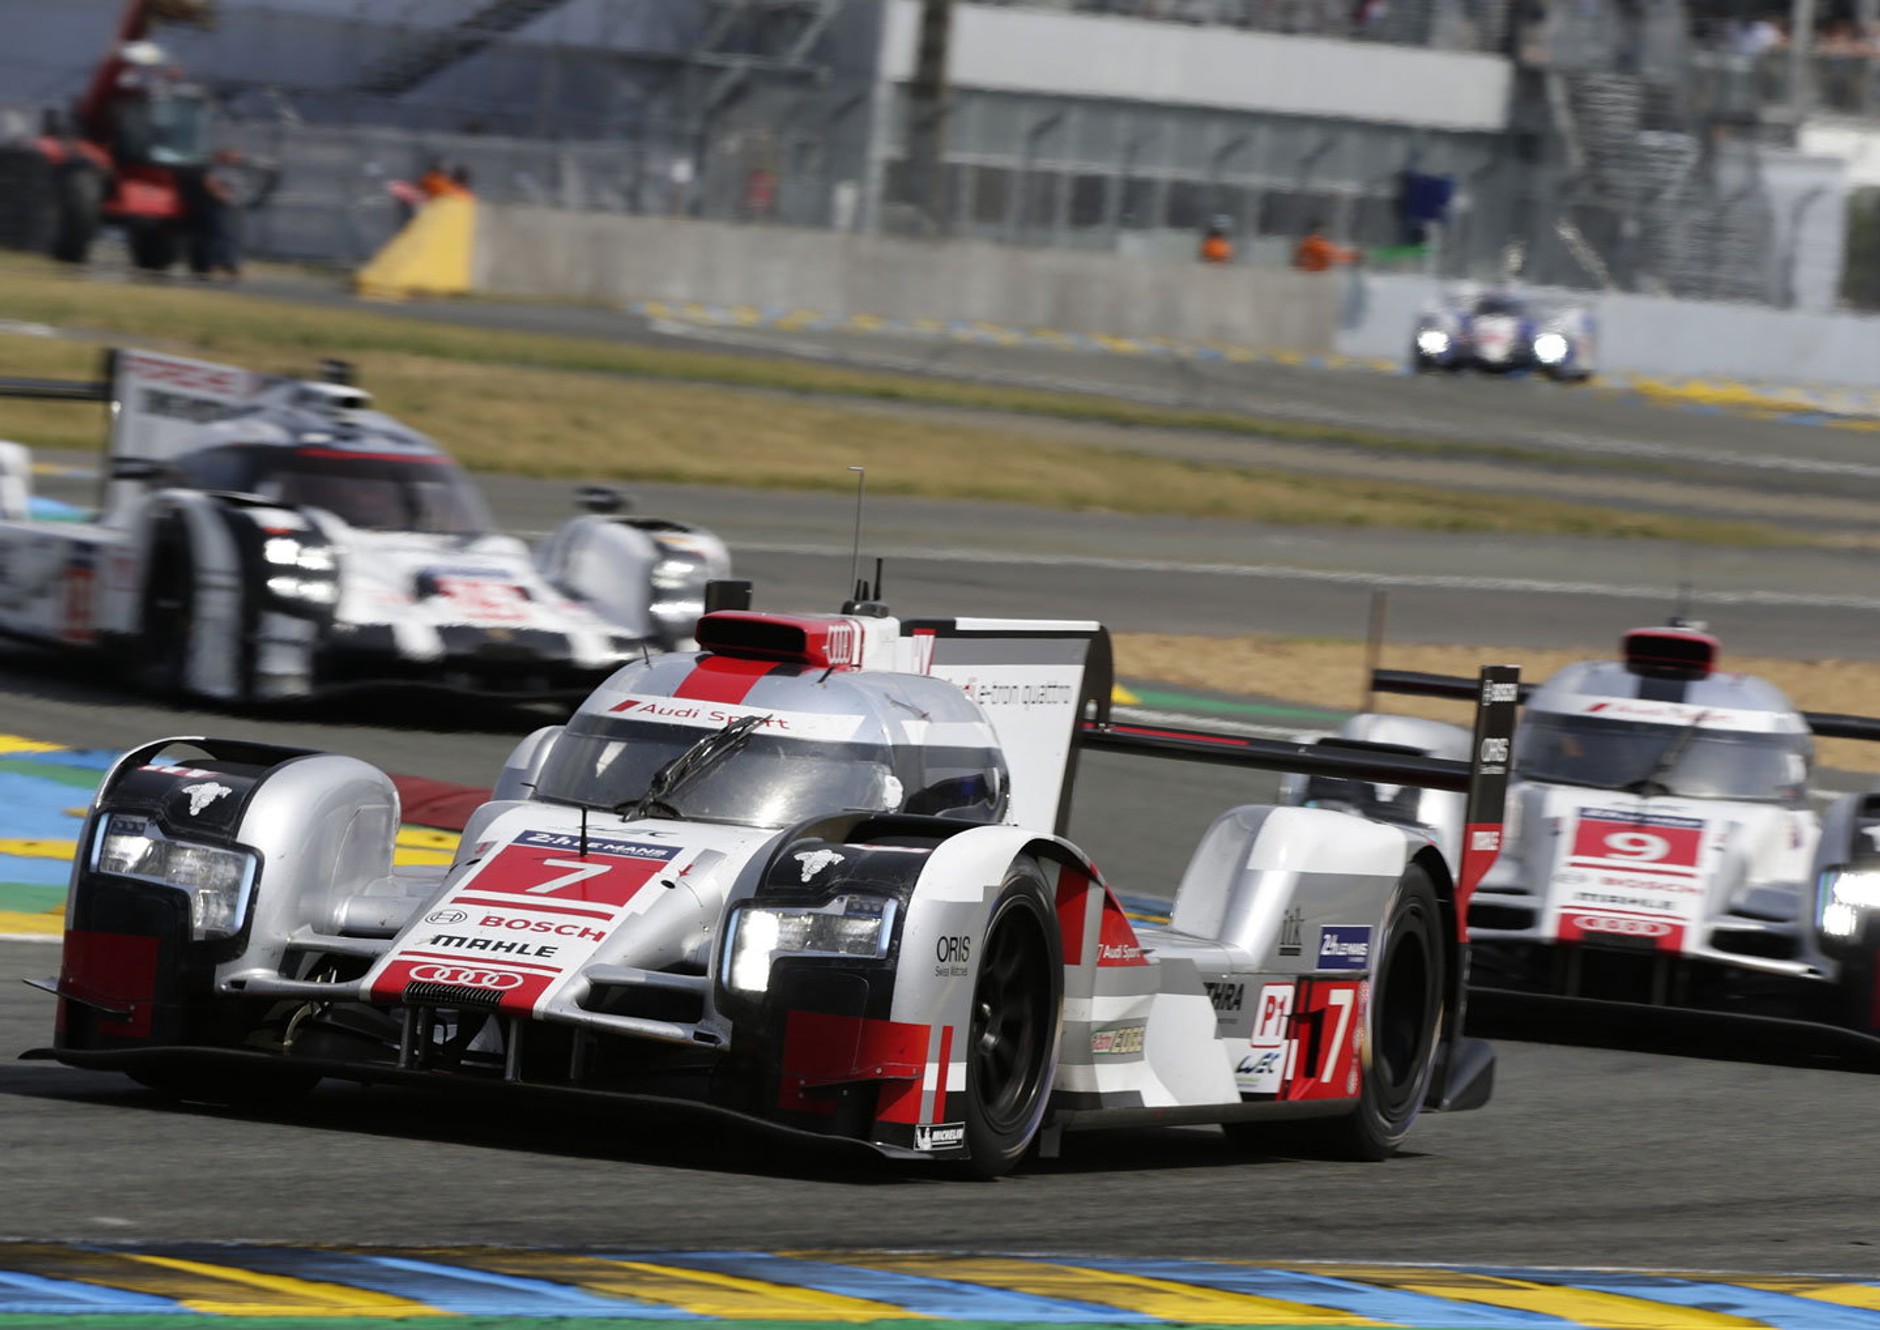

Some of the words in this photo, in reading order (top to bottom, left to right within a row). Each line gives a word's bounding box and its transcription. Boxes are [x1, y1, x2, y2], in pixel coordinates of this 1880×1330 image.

[638, 703, 700, 719] Audi
[1603, 831, 1671, 863] 9
[525, 858, 613, 894] 7
[478, 915, 606, 942] BOSCH
[430, 934, 559, 958] MAHLE
[936, 935, 971, 963] ORIS
[1102, 944, 1122, 959] Audi
[1260, 994, 1287, 1037] P1
